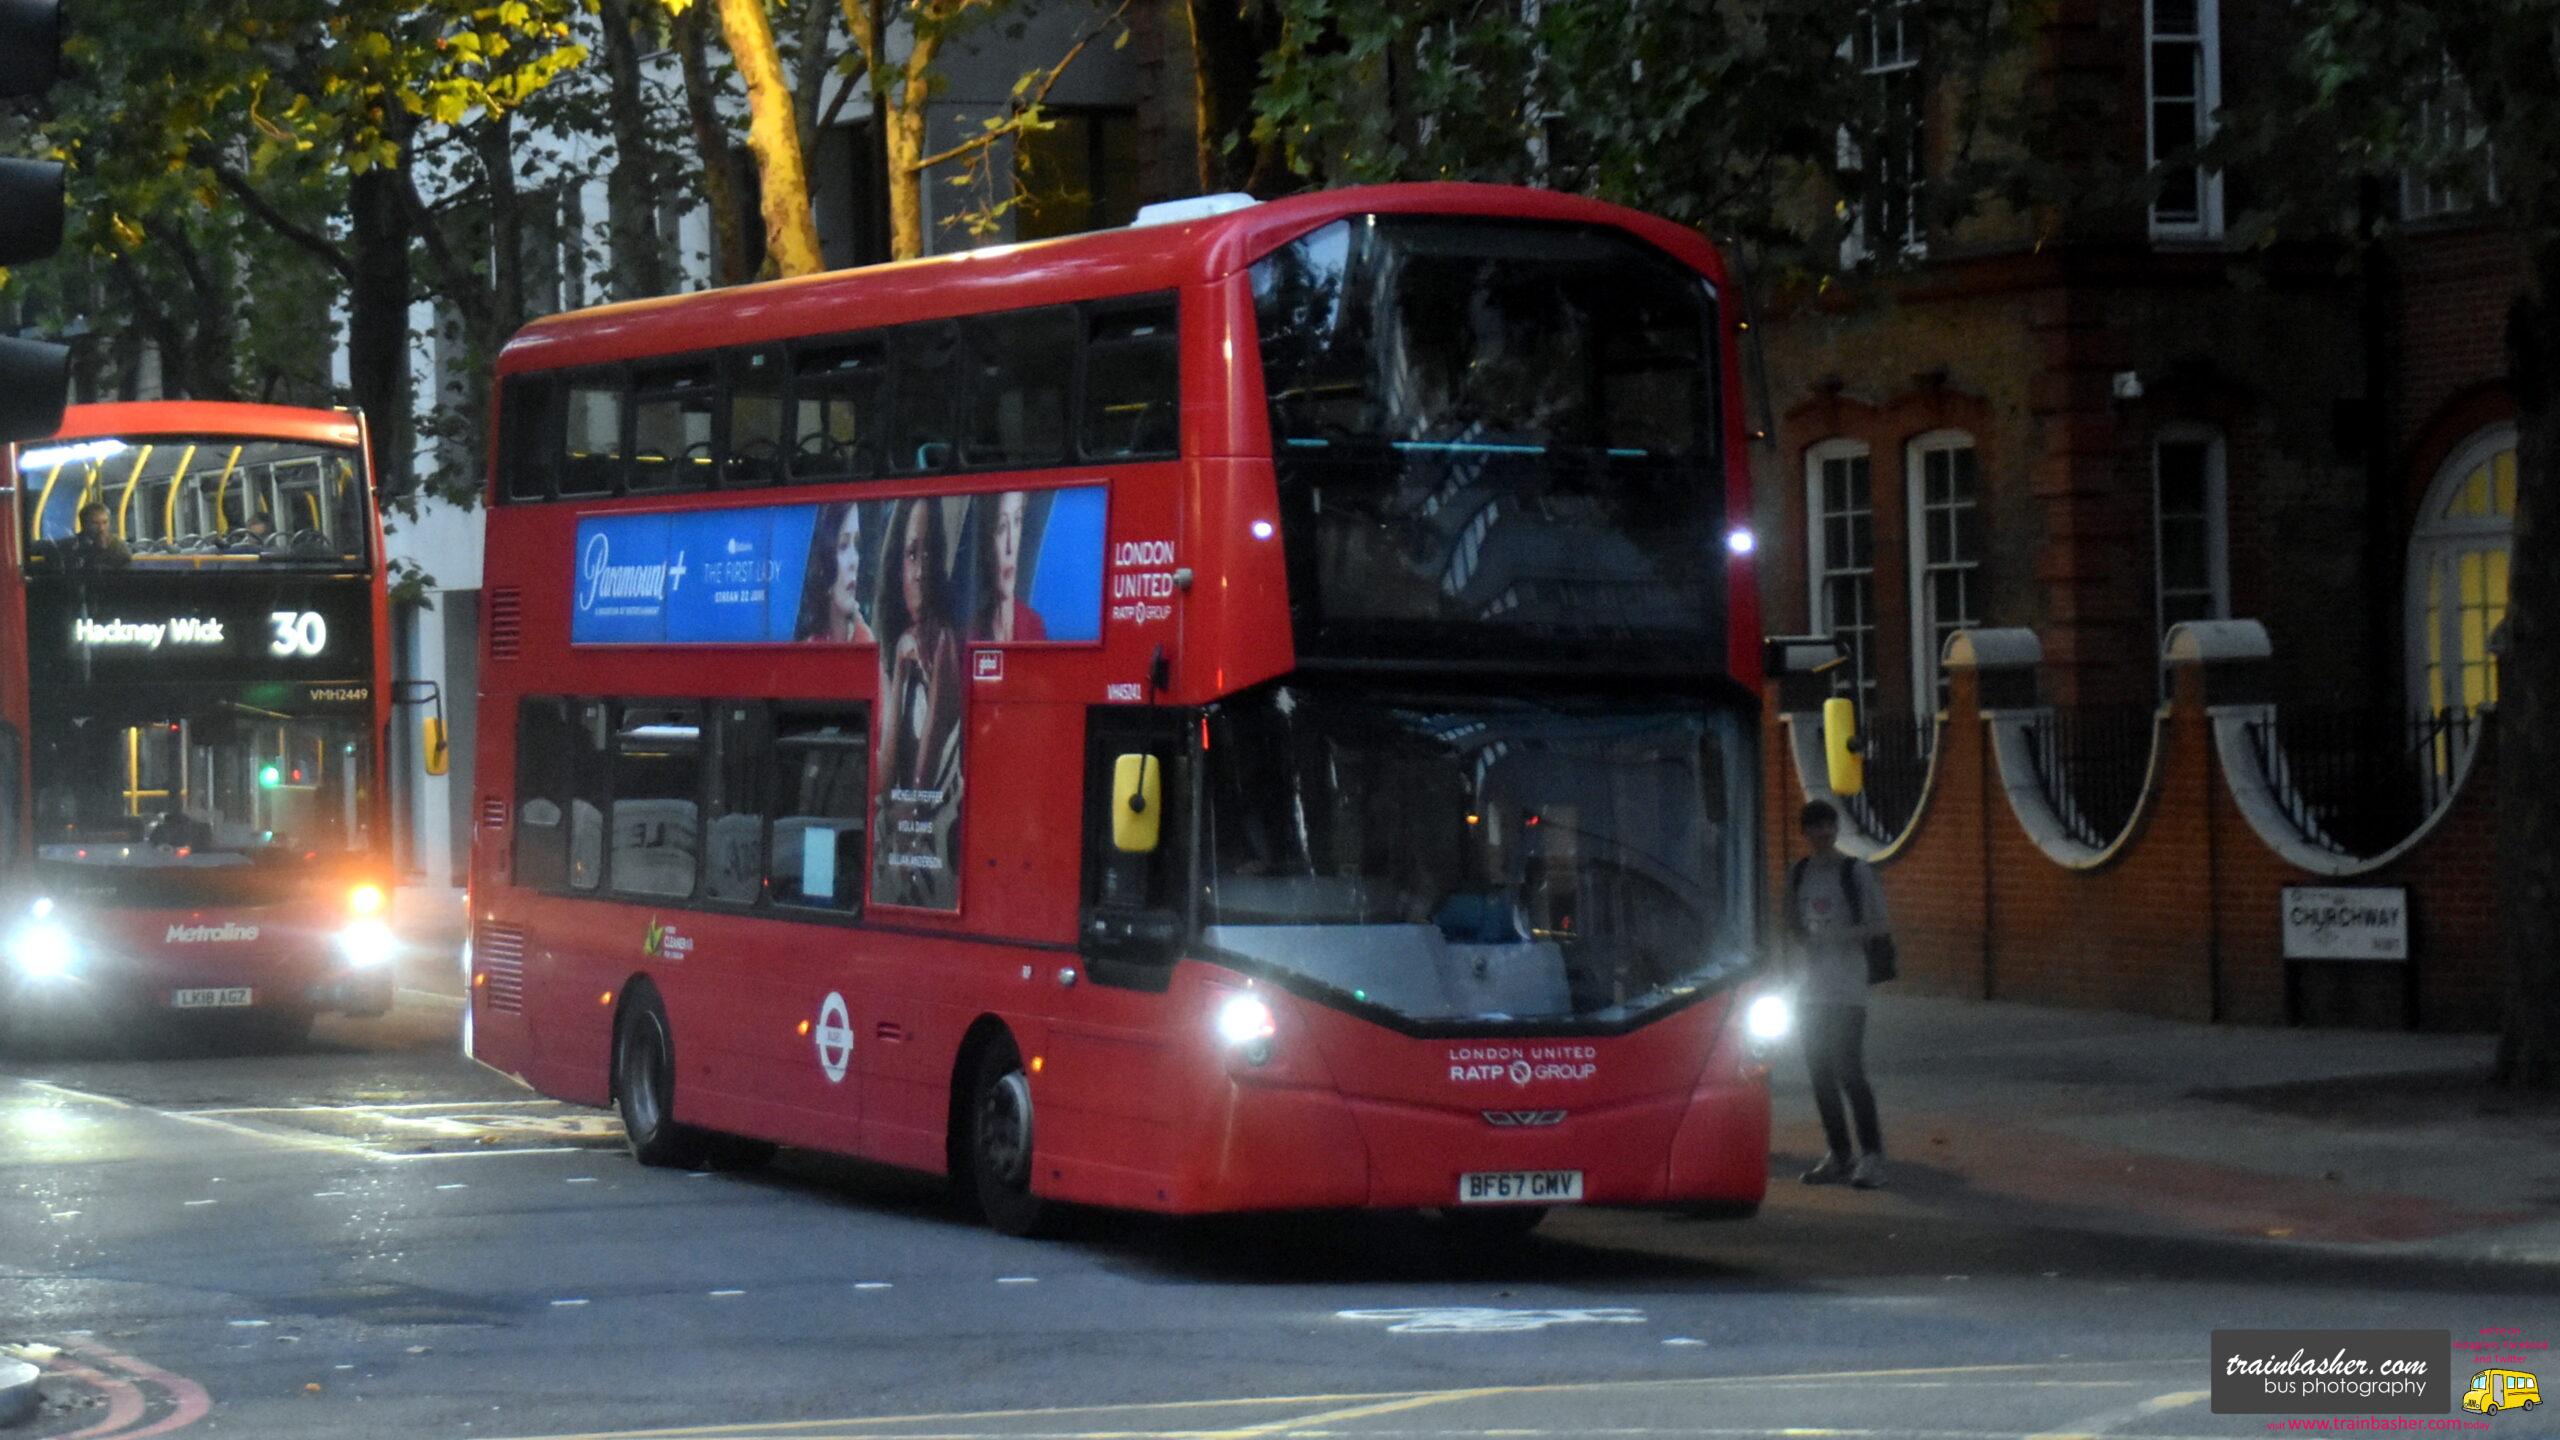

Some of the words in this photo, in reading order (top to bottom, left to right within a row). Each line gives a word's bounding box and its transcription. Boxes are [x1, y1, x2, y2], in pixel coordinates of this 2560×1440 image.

[1115, 541, 1174, 565] LONDON
[705, 563, 722, 583] THE
[726, 561, 754, 583] FIRST
[1114, 573, 1173, 597] UNITED
[1113, 605, 1135, 620] RATP
[76, 619, 167, 648] Hackney
[170, 618, 224, 641] Wick
[271, 612, 326, 655] 30
[310, 688, 368, 701] VMH2449
[2290, 907, 2399, 927] CHURCHWAY
[166, 923, 259, 943] Metroline
[182, 990, 215, 1005] LK18
[220, 989, 247, 1004] AGZ
[1449, 1048, 1523, 1060] LONDON
[1532, 1046, 1596, 1059] UNITED
[1450, 1065, 1504, 1081] RATP
[1534, 1064, 1596, 1080] GROUP
[1469, 1174, 1526, 1197] BF67
[1531, 1173, 1574, 1195] GMV
